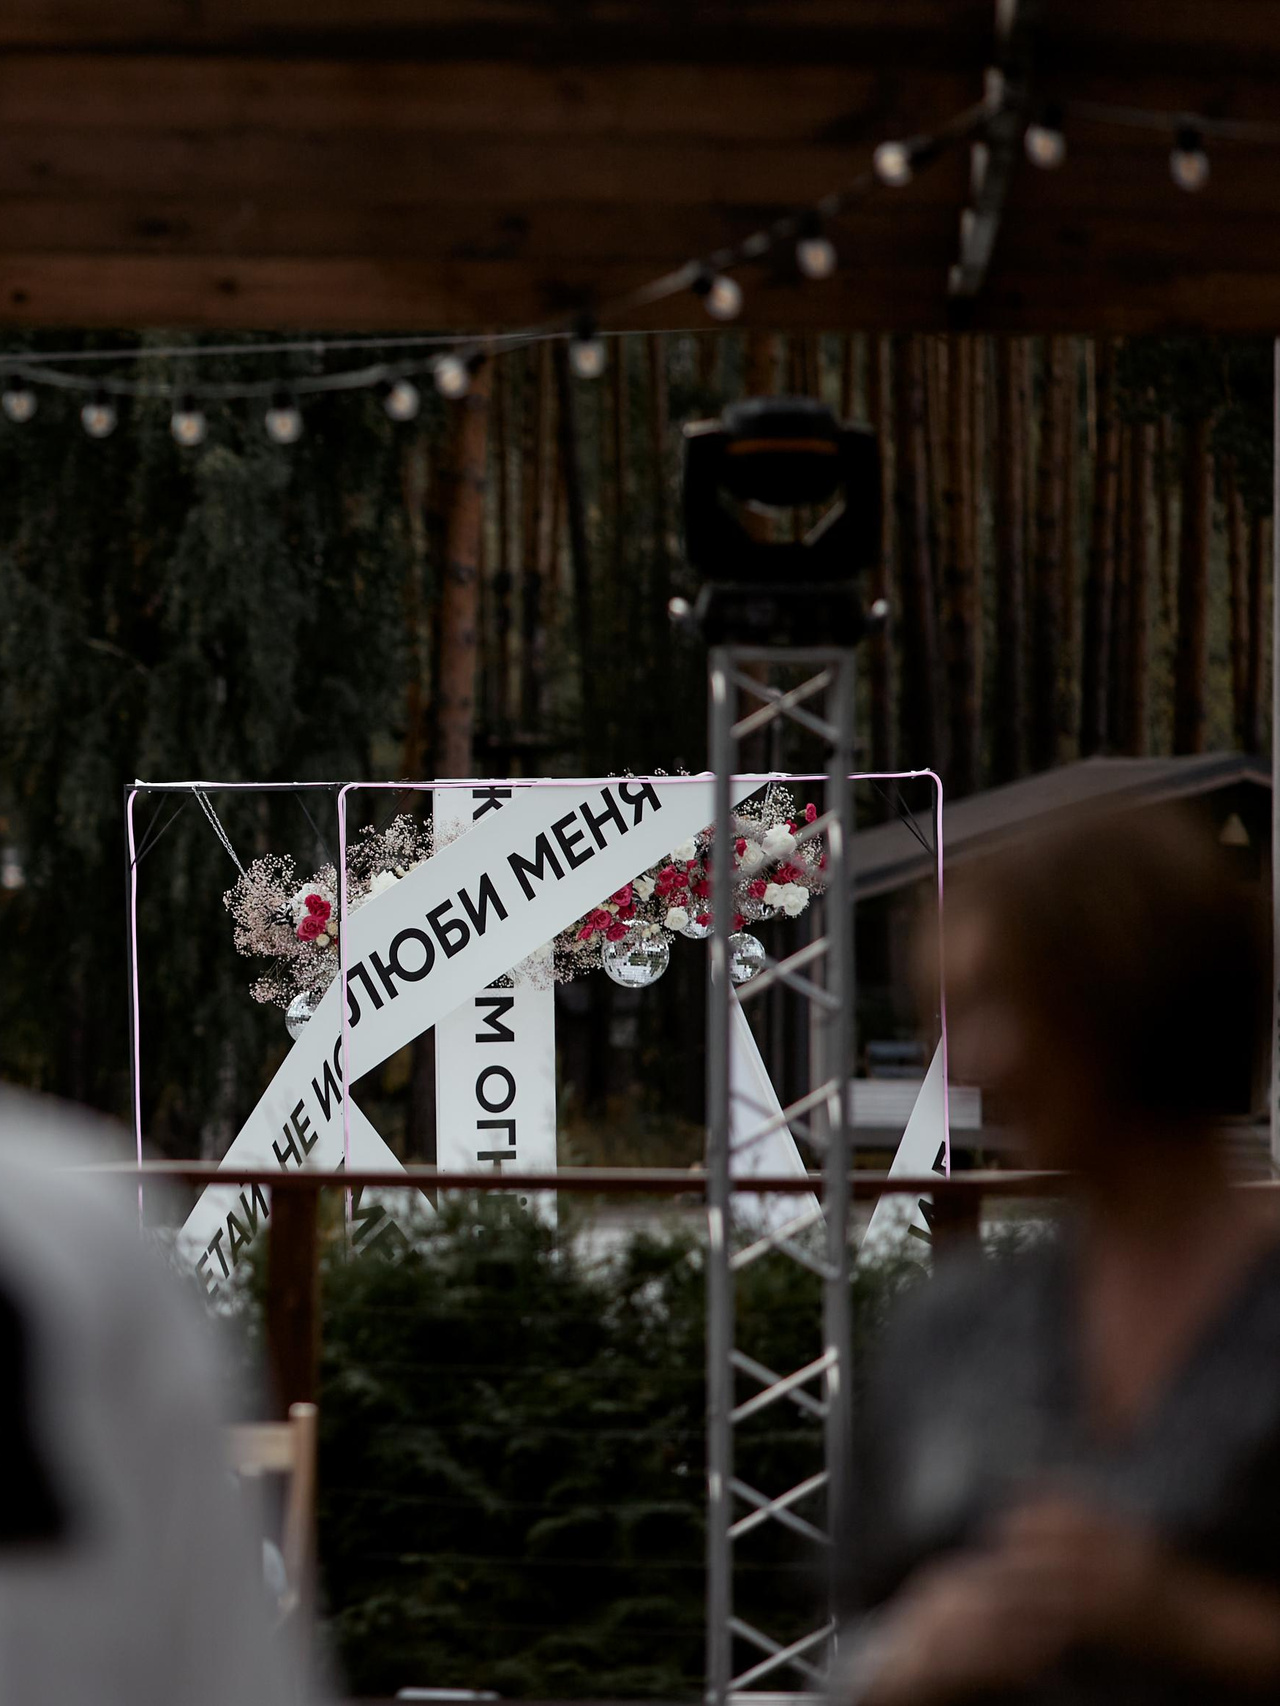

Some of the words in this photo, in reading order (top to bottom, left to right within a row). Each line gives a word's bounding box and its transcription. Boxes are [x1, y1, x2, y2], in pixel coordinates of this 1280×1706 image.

[346, 872, 509, 1029] ЛЮБИ
[506, 781, 663, 902] МЕНЯ
[271, 1098, 319, 1173] НЕ
